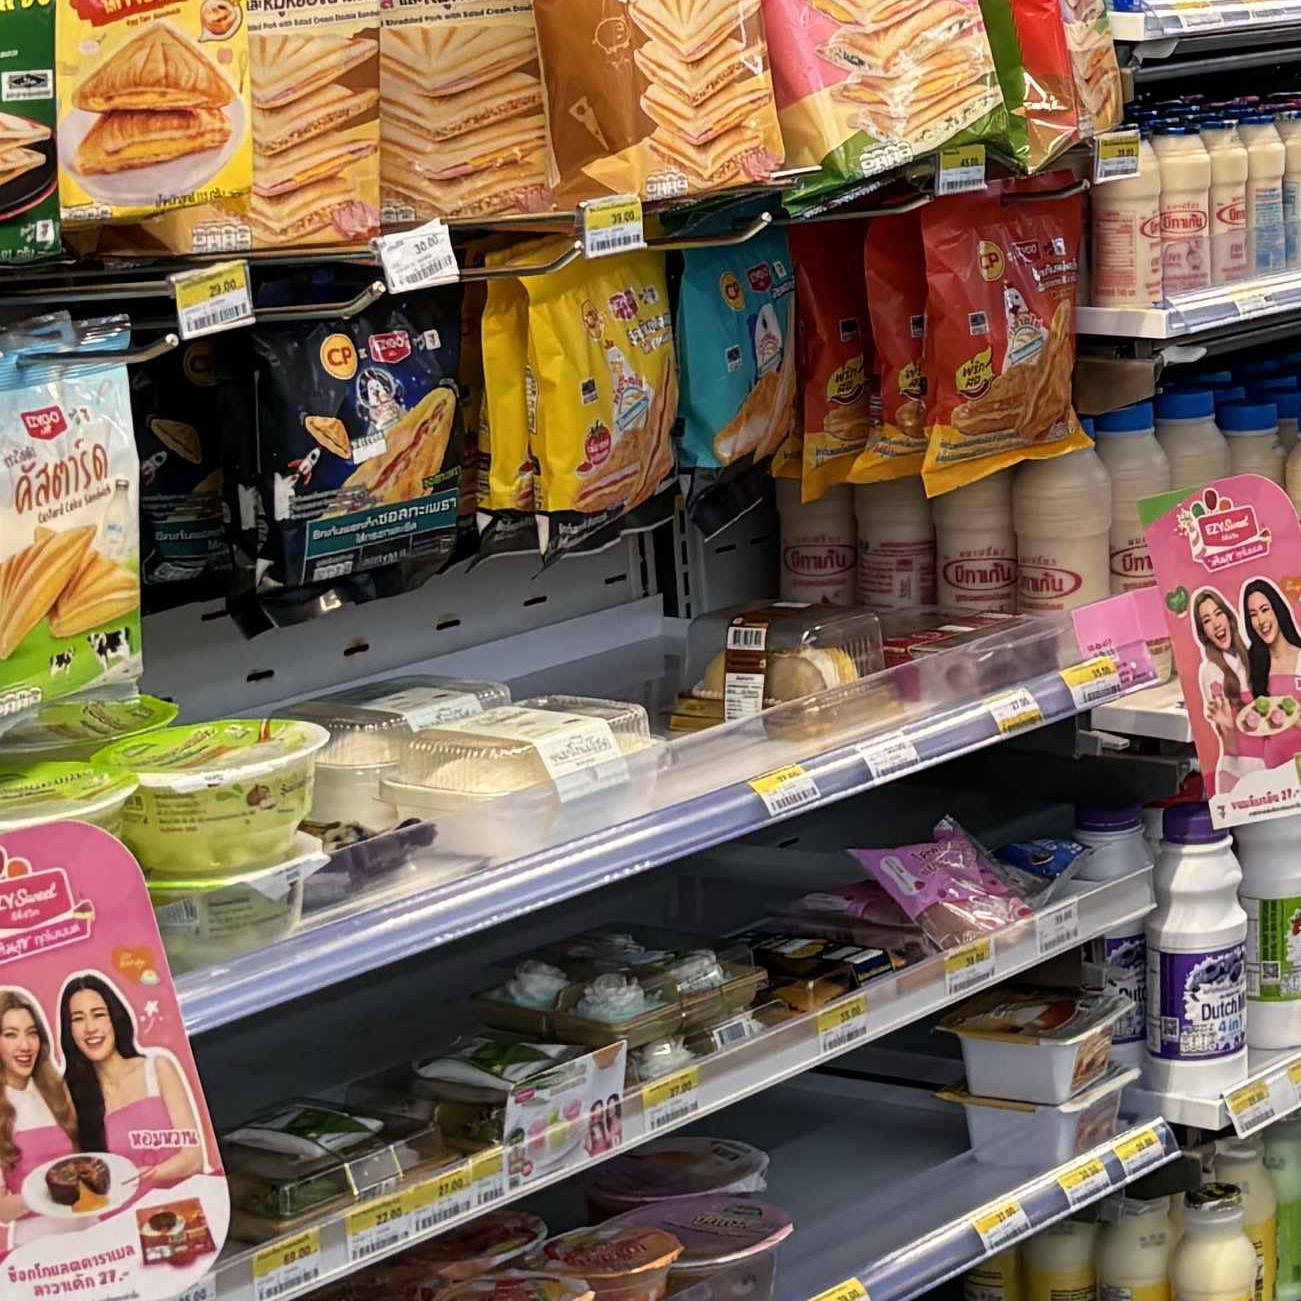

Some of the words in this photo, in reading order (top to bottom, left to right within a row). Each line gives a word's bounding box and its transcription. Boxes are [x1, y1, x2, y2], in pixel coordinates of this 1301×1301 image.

[980, 251, 999, 270] CP
[327, 348, 351, 366] CP
[14, 437, 108, 515] คัสตาร์ด
[1201, 998, 1237, 1021] Dutch
